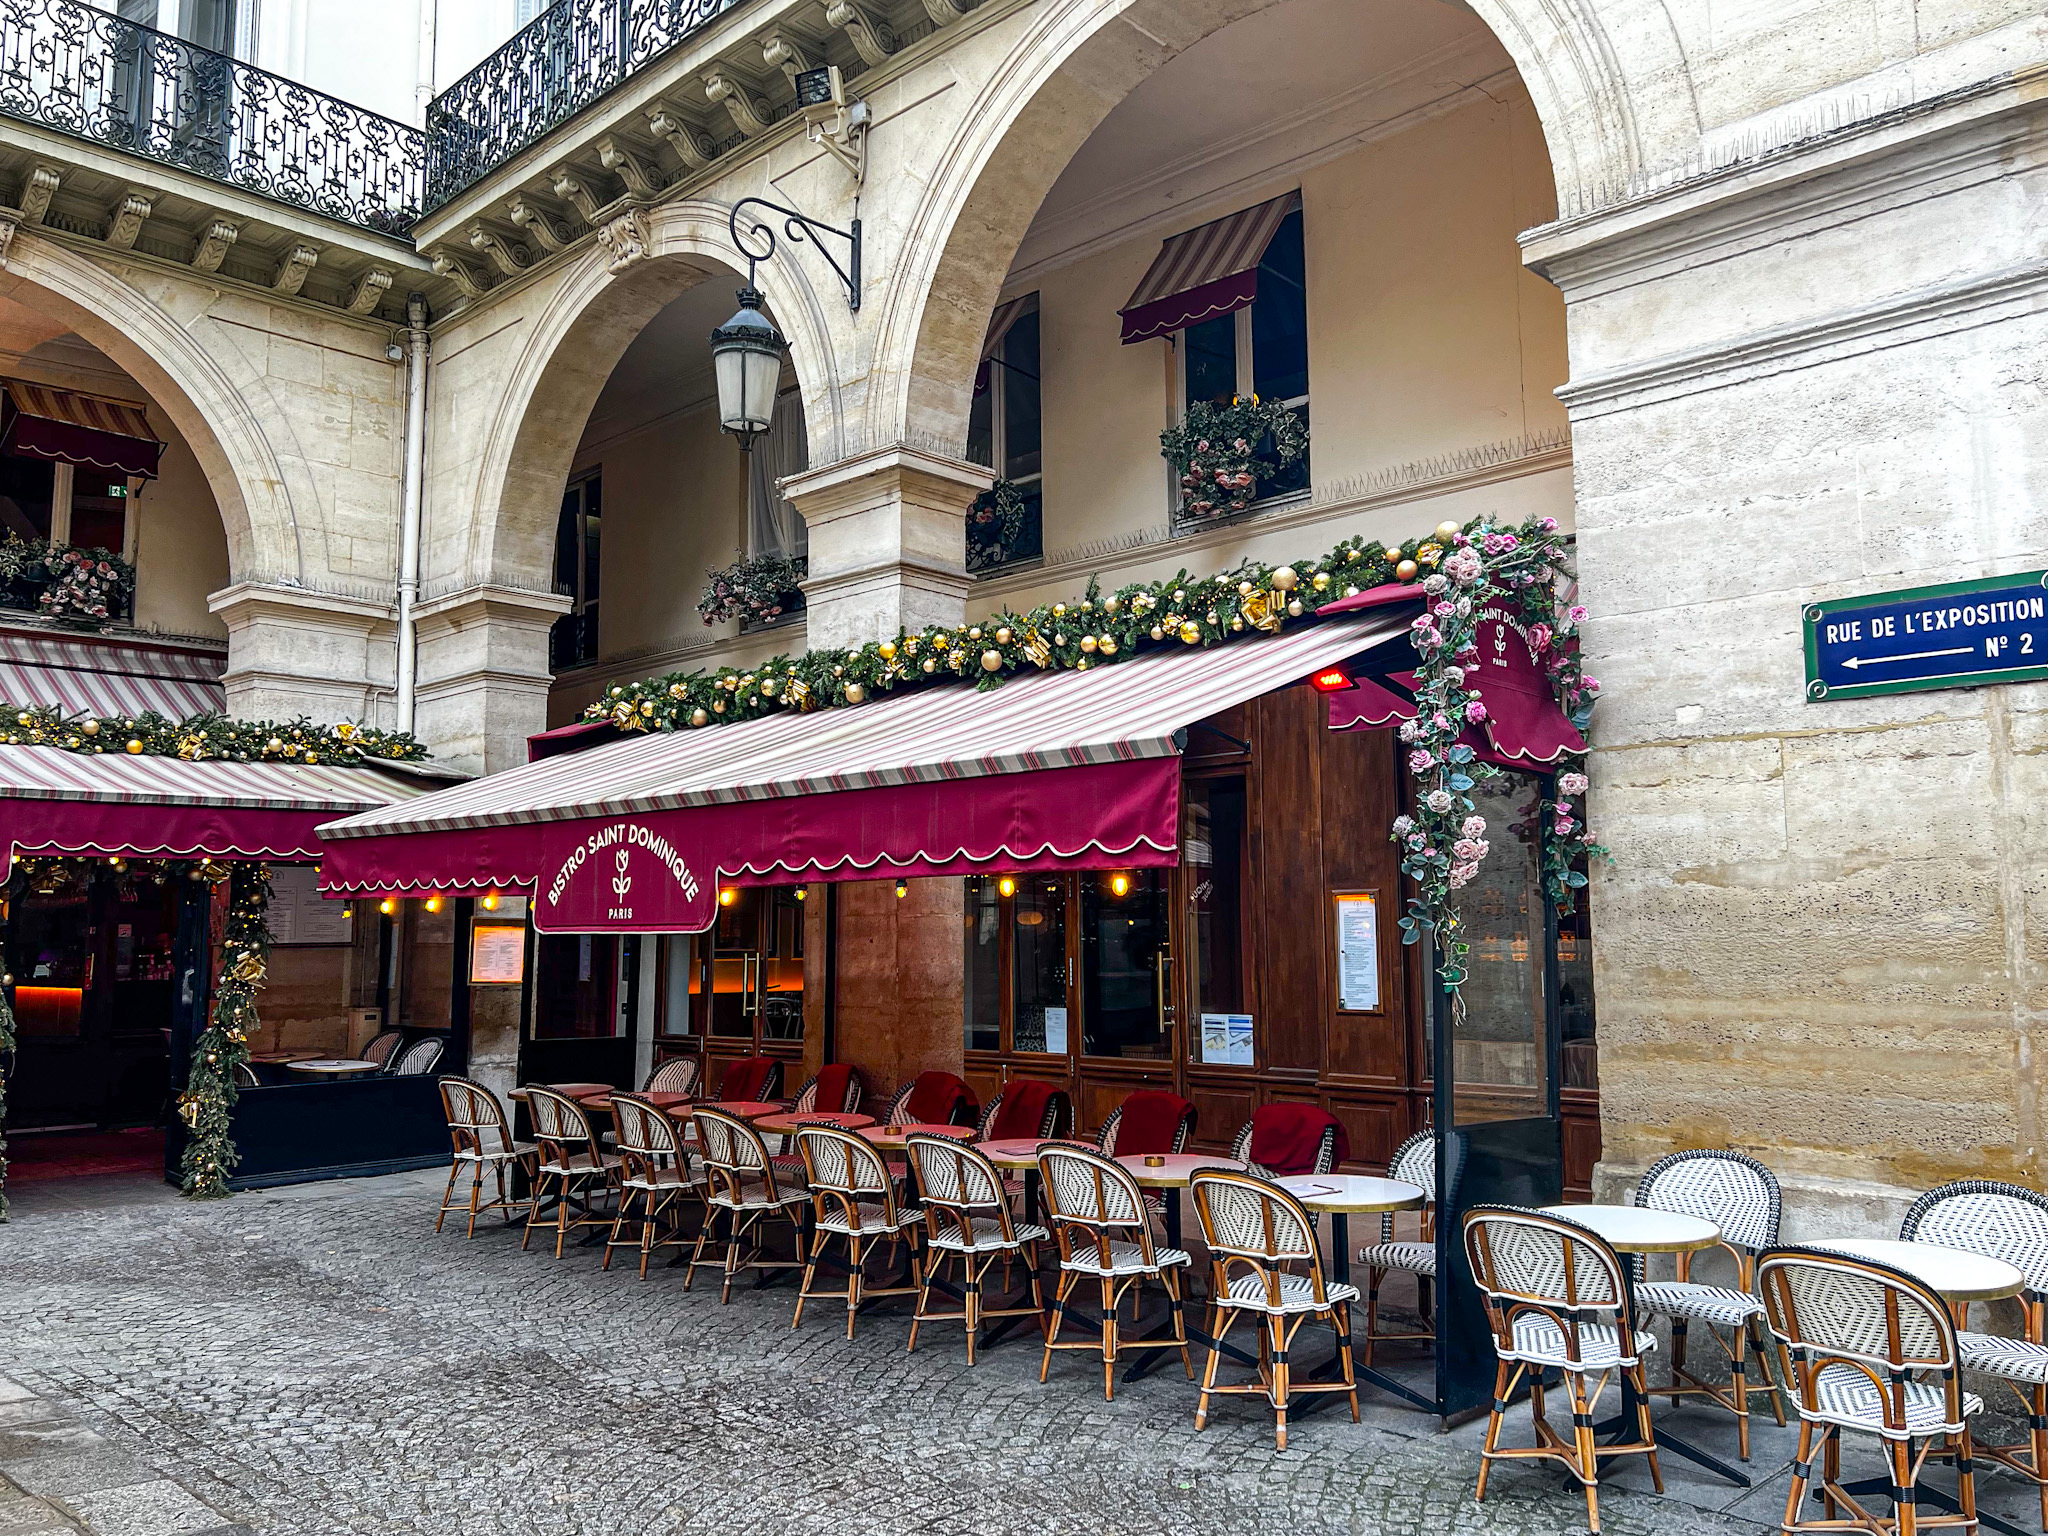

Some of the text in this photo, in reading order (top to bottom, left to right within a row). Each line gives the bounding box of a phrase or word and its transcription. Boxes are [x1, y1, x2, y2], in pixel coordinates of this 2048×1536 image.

[1826, 597, 2044, 644] RUE DE L'EXPOSITION
[2019, 633, 2034, 654] 2
[547, 823, 700, 907] BISTRO SAINT DOMINIQUE
[608, 907, 633, 920] PARIS
